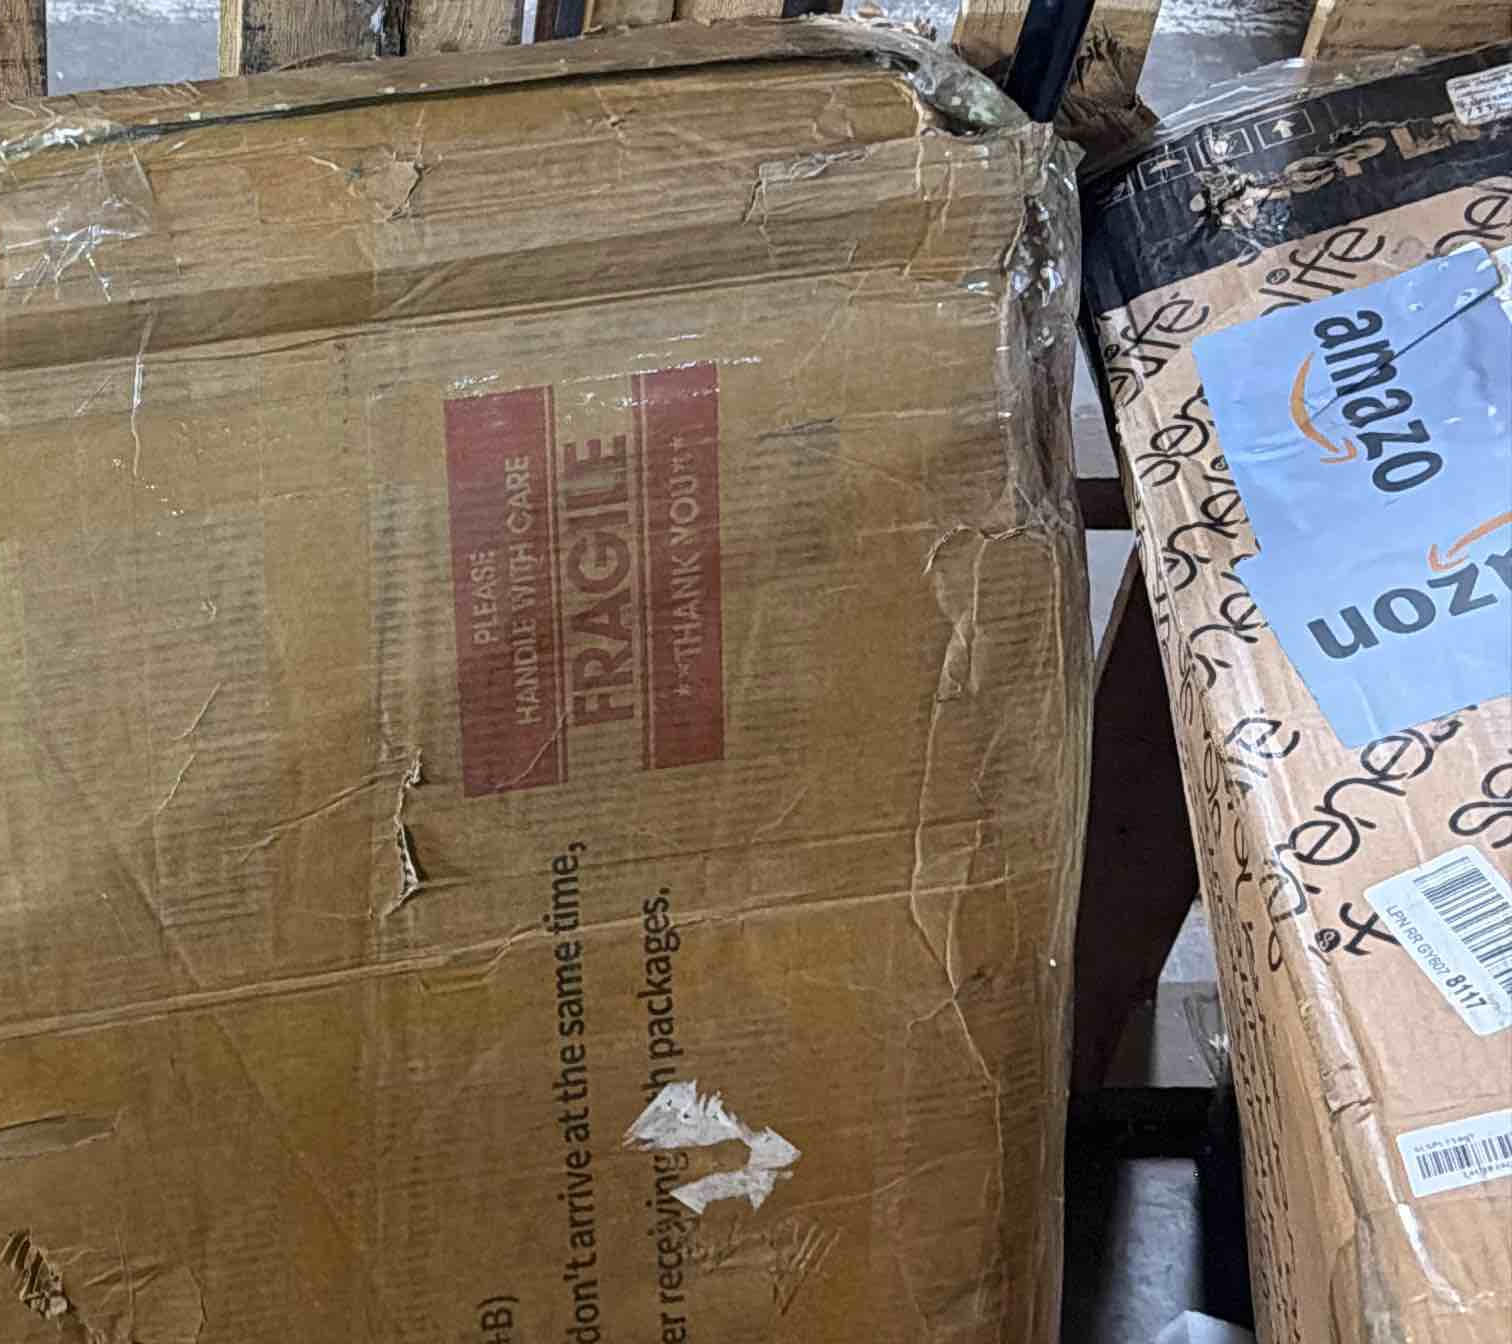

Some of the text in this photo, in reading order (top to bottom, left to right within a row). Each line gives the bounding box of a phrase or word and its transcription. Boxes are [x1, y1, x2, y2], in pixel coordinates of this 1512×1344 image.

[471, 551, 497, 647] PLEASE
[505, 455, 543, 726] HANDLE WITH CARE
[560, 432, 638, 728] FRAGILE
[543, 841, 586, 934] time,
[554, 943, 585, 1037] same
[638, 887, 683, 1059] packages.
[553, 1044, 588, 1102] the
[559, 1106, 590, 1143] at
[558, 1151, 597, 1247] arrive
[563, 1257, 600, 1344] don't
